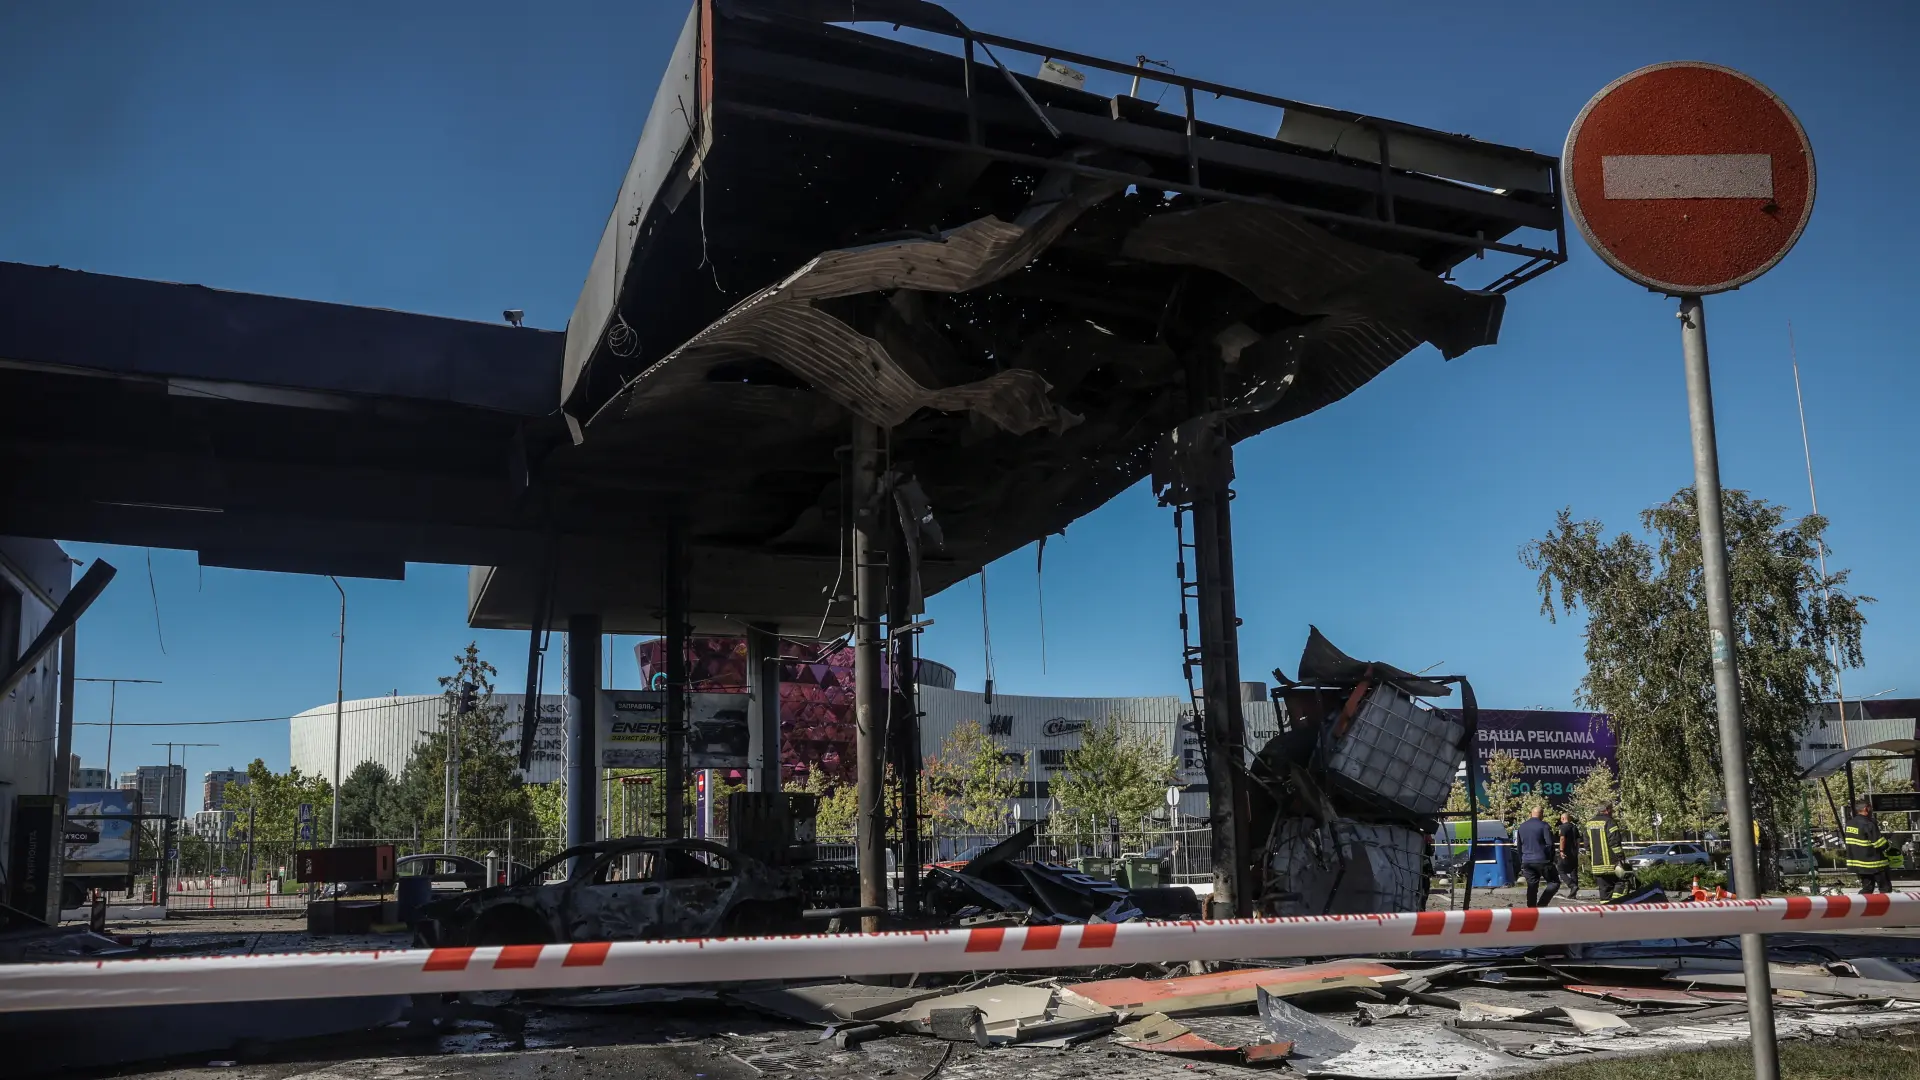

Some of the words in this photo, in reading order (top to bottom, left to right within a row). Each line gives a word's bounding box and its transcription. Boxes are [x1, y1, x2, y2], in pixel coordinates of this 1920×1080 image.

[518, 704, 565, 712] MNGO
[618, 703, 655, 711] ЗАПРАВЛЯ
[611, 722, 668, 733] ENERG
[1254, 731, 1280, 739] ULTR
[1478, 729, 1527, 742] ВАША
[1528, 730, 1596, 743] РЕКЛАМА
[1543, 749, 1597, 760] ЕКРАНАХ
[1517, 765, 1571, 776] ПУБЛІКА
[1511, 782, 1531, 796] 50
[1543, 782, 1563, 796] 38
